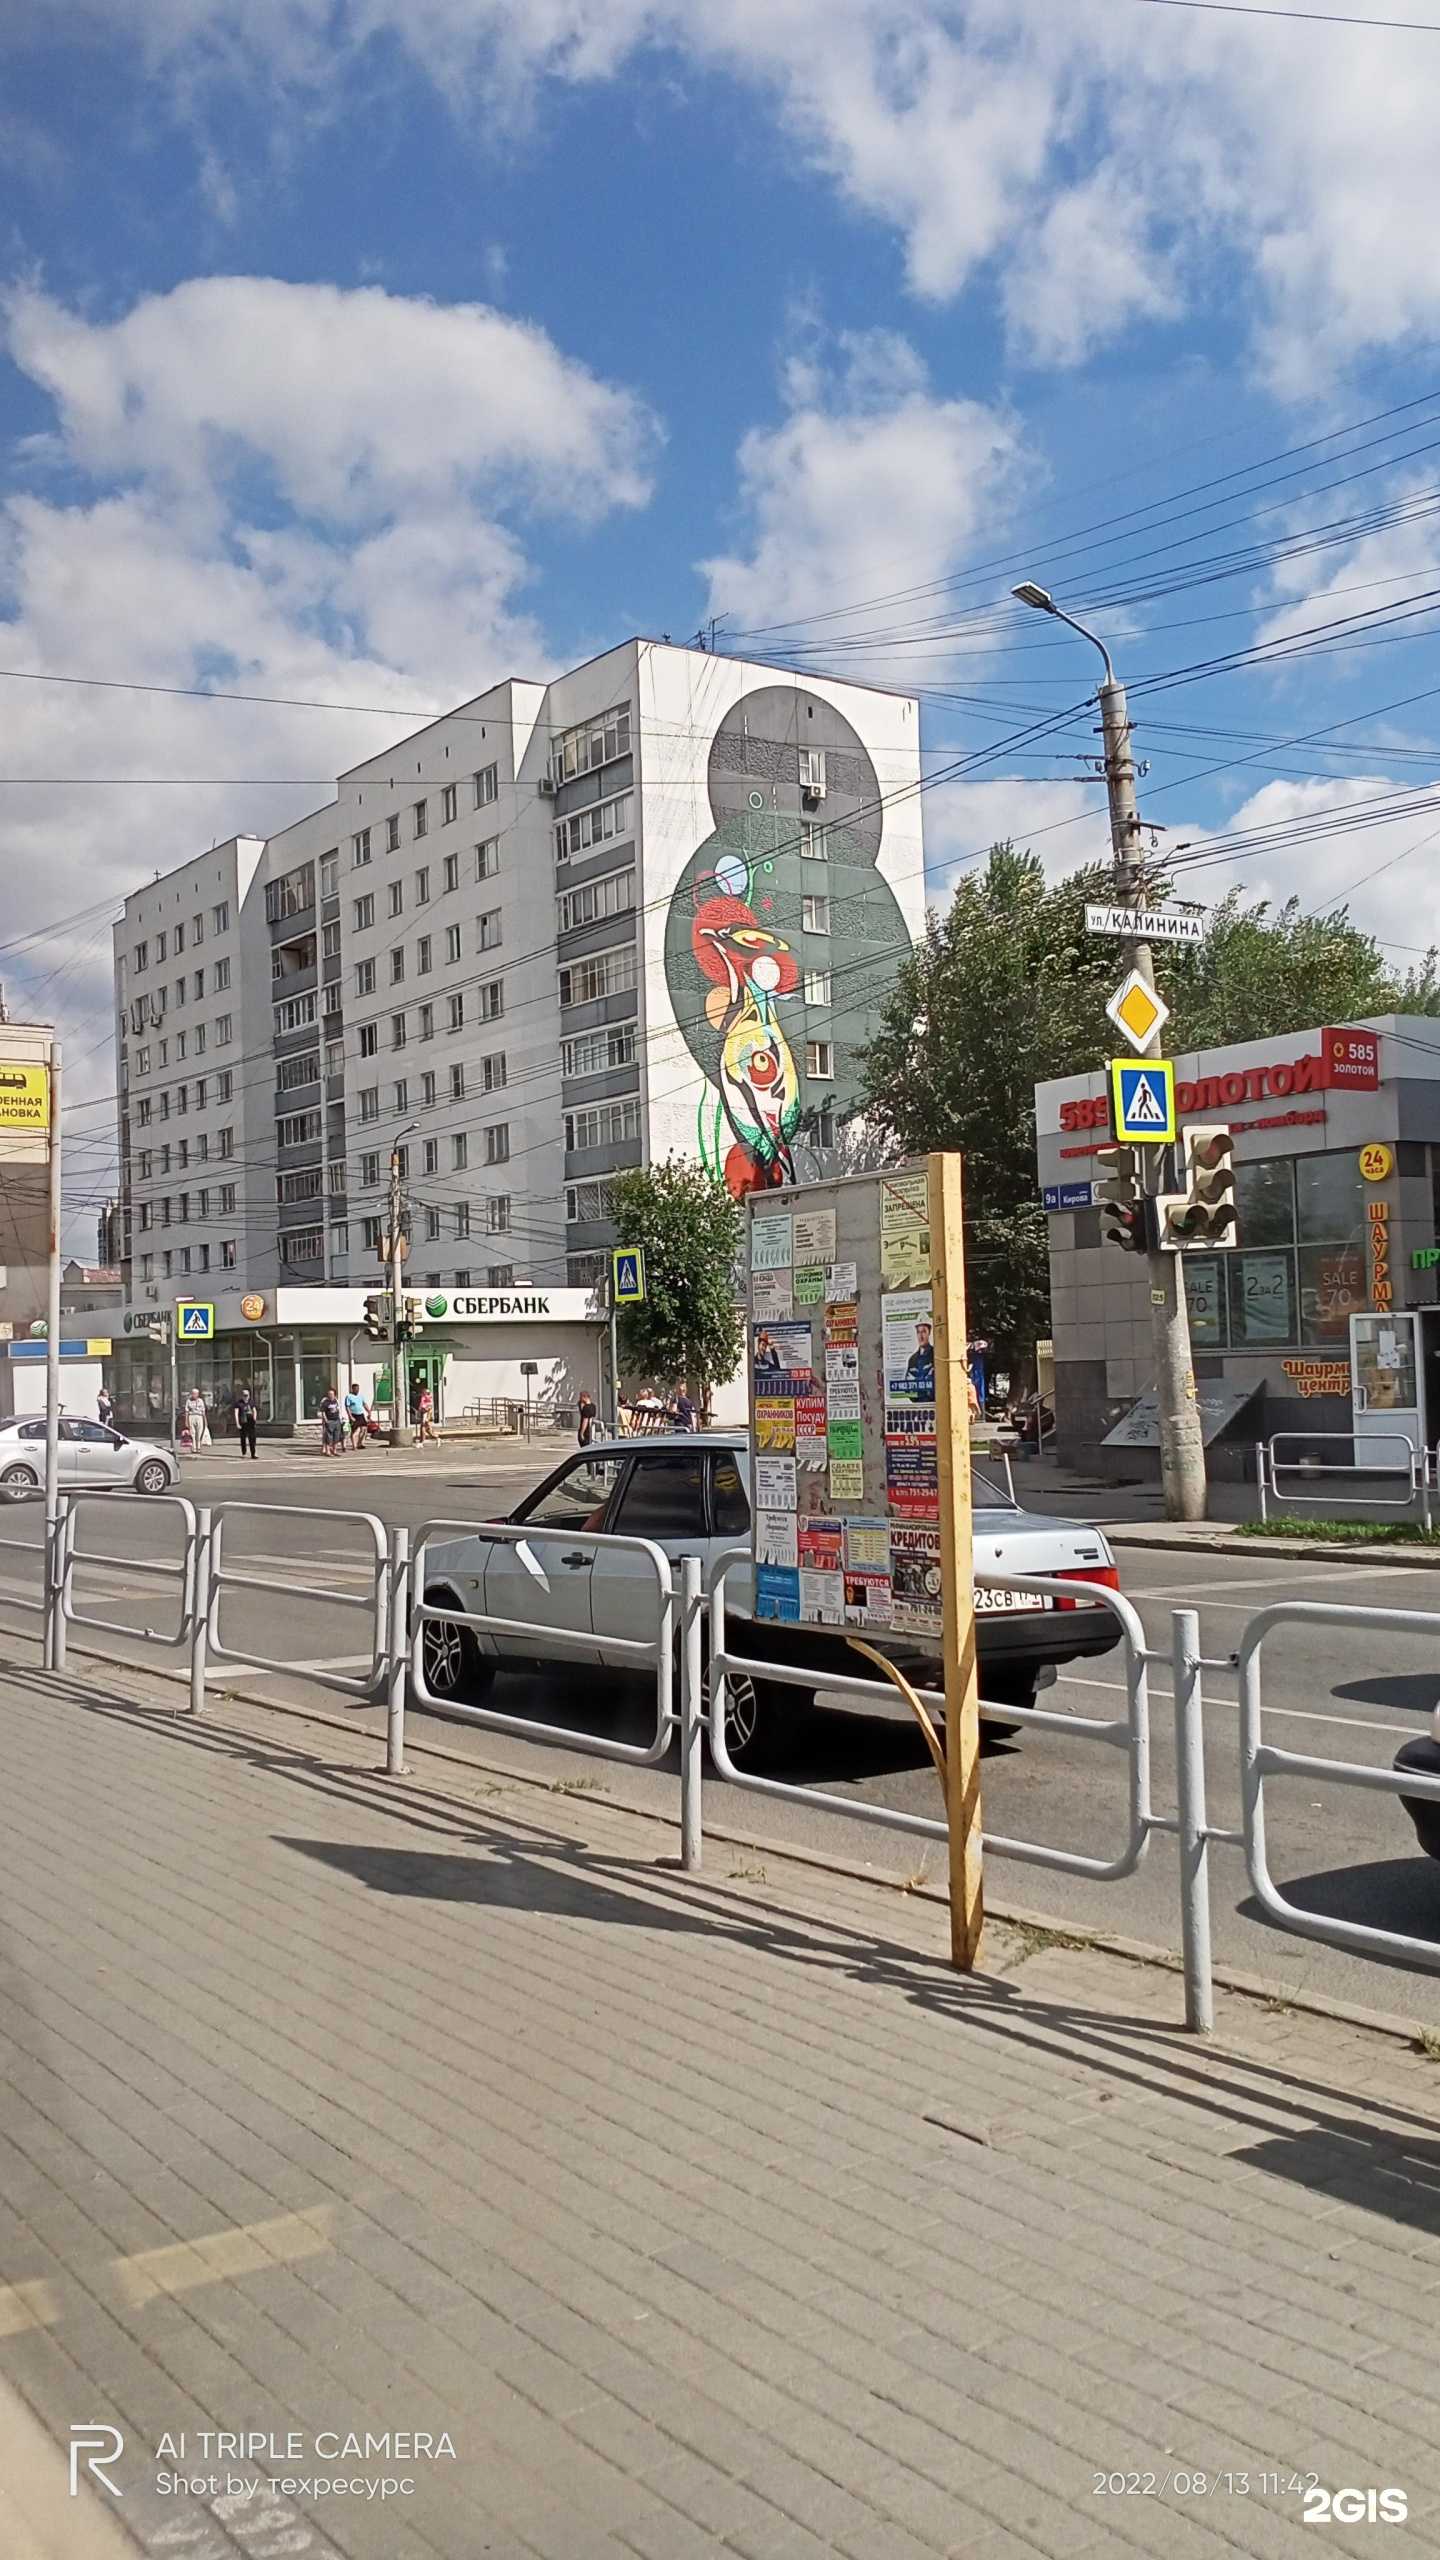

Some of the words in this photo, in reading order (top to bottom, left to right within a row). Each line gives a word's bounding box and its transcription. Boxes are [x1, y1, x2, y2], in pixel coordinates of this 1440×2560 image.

[1112, 913, 1200, 937] КАЛИНИНА
[1348, 1043, 1375, 1061] 585
[1333, 1063, 1375, 1076] ЗОЛОТОЙ
[1059, 1095, 1108, 1132] 585
[1175, 1054, 1323, 1115] ОЛОТОЙ
[0, 1108, 41, 1118] НОВКА
[1363, 1150, 1384, 1167] 24
[1365, 1166, 1384, 1174] часа
[1045, 1193, 1057, 1205] 9а
[1062, 1194, 1089, 1205] Кирова
[884, 1199, 926, 1214] ЗАПРЕЩЕНА
[1322, 1271, 1358, 1286] SALE
[453, 1296, 550, 1315] СБЕРБАНК
[1299, 1380, 1350, 1396] центр
[796, 1397, 825, 1409] КУПИМ
[756, 1409, 793, 1420] ОХРАННИКОВ
[796, 1411, 825, 1425] Посуду
[798, 1425, 815, 1435] СССР
[886, 1421, 927, 1434] КРЕДИТ
[890, 1531, 941, 1550] КРЕДИТОВ
[845, 1576, 889, 1587] ТРЕБУЮТСЯ
[973, 1588, 1013, 1609] 23СВ
